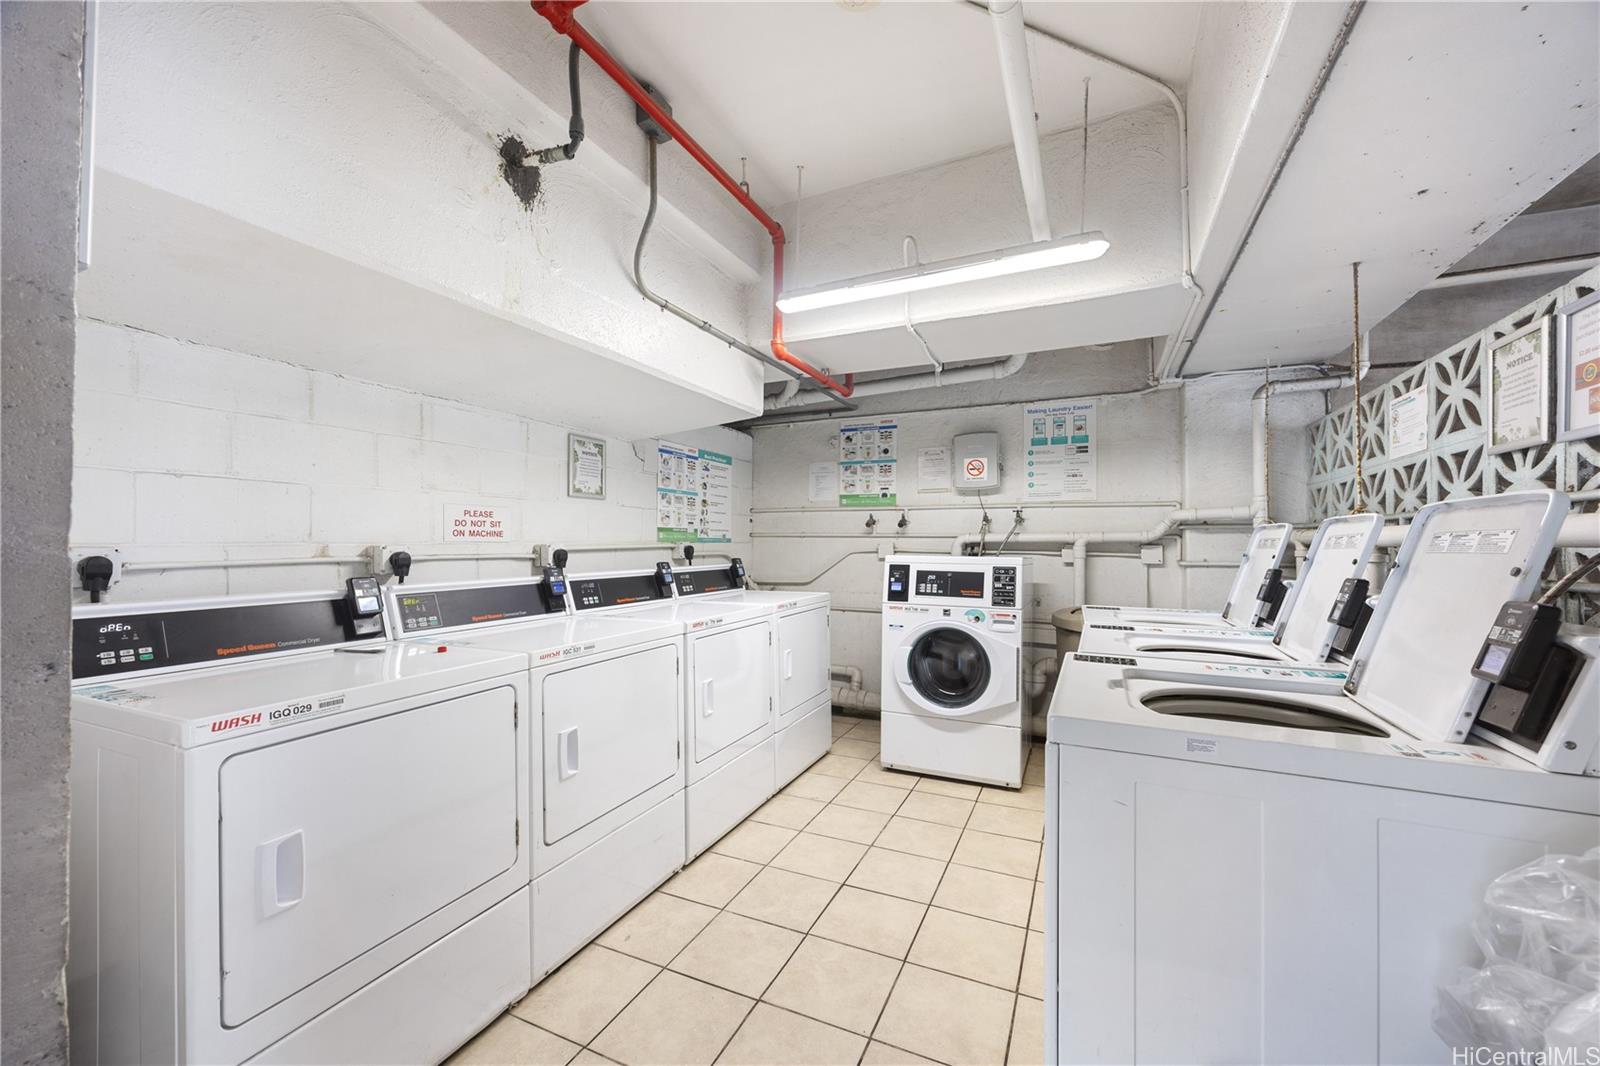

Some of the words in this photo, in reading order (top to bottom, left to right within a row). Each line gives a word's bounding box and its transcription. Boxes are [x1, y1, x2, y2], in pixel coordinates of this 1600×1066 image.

[1506, 353, 1533, 369] NOTICE
[464, 509, 494, 518] PLEASE
[454, 519, 467, 527] DO
[470, 520, 487, 528] NOT
[489, 520, 502, 528] SIT
[452, 529, 465, 537] ON
[468, 530, 504, 538] MACHINE
[217, 645, 247, 656] Speed
[248, 642, 276, 652] Queen
[277, 639, 307, 648] Commercial
[308, 637, 321, 645] Dryer
[211, 713, 262, 732] WASH
[269, 708, 291, 721] IGQ
[293, 703, 313, 715] 029
